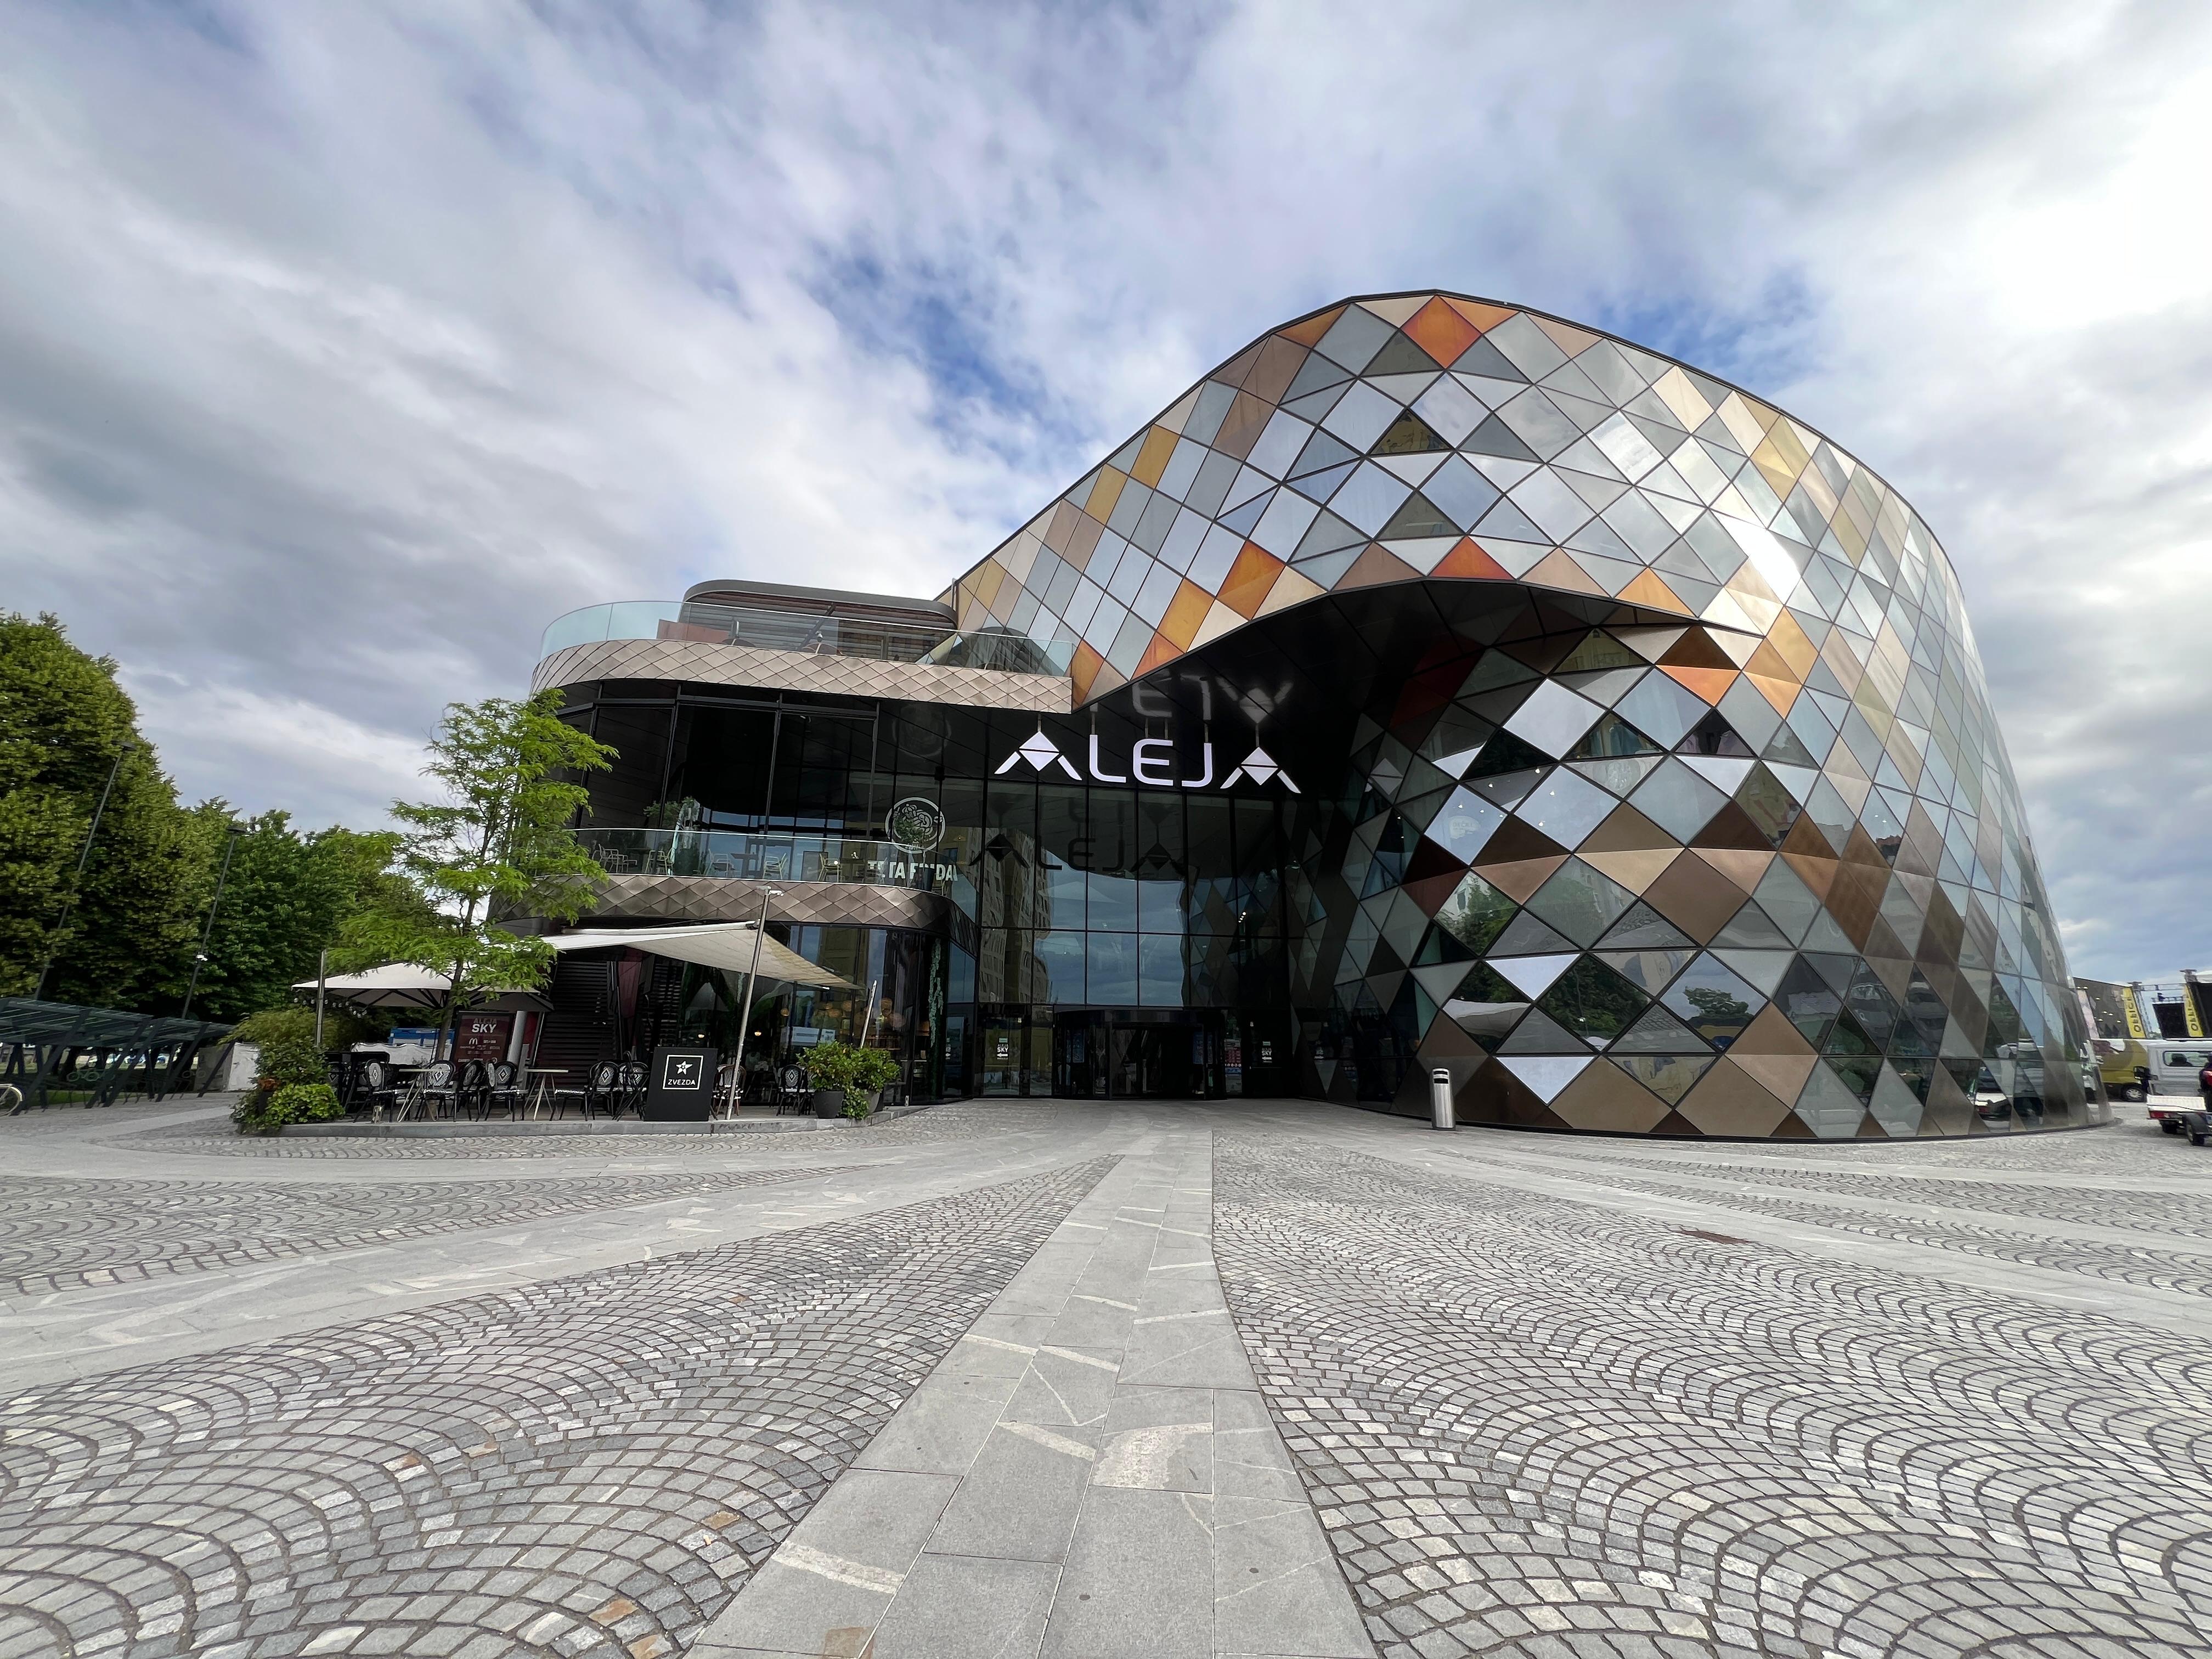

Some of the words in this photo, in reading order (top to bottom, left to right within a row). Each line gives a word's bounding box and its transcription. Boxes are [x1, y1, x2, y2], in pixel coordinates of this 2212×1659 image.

[994, 731, 1301, 793] ALEJA
[910, 863, 958, 881] FDA
[472, 1024, 496, 1032] SKY
